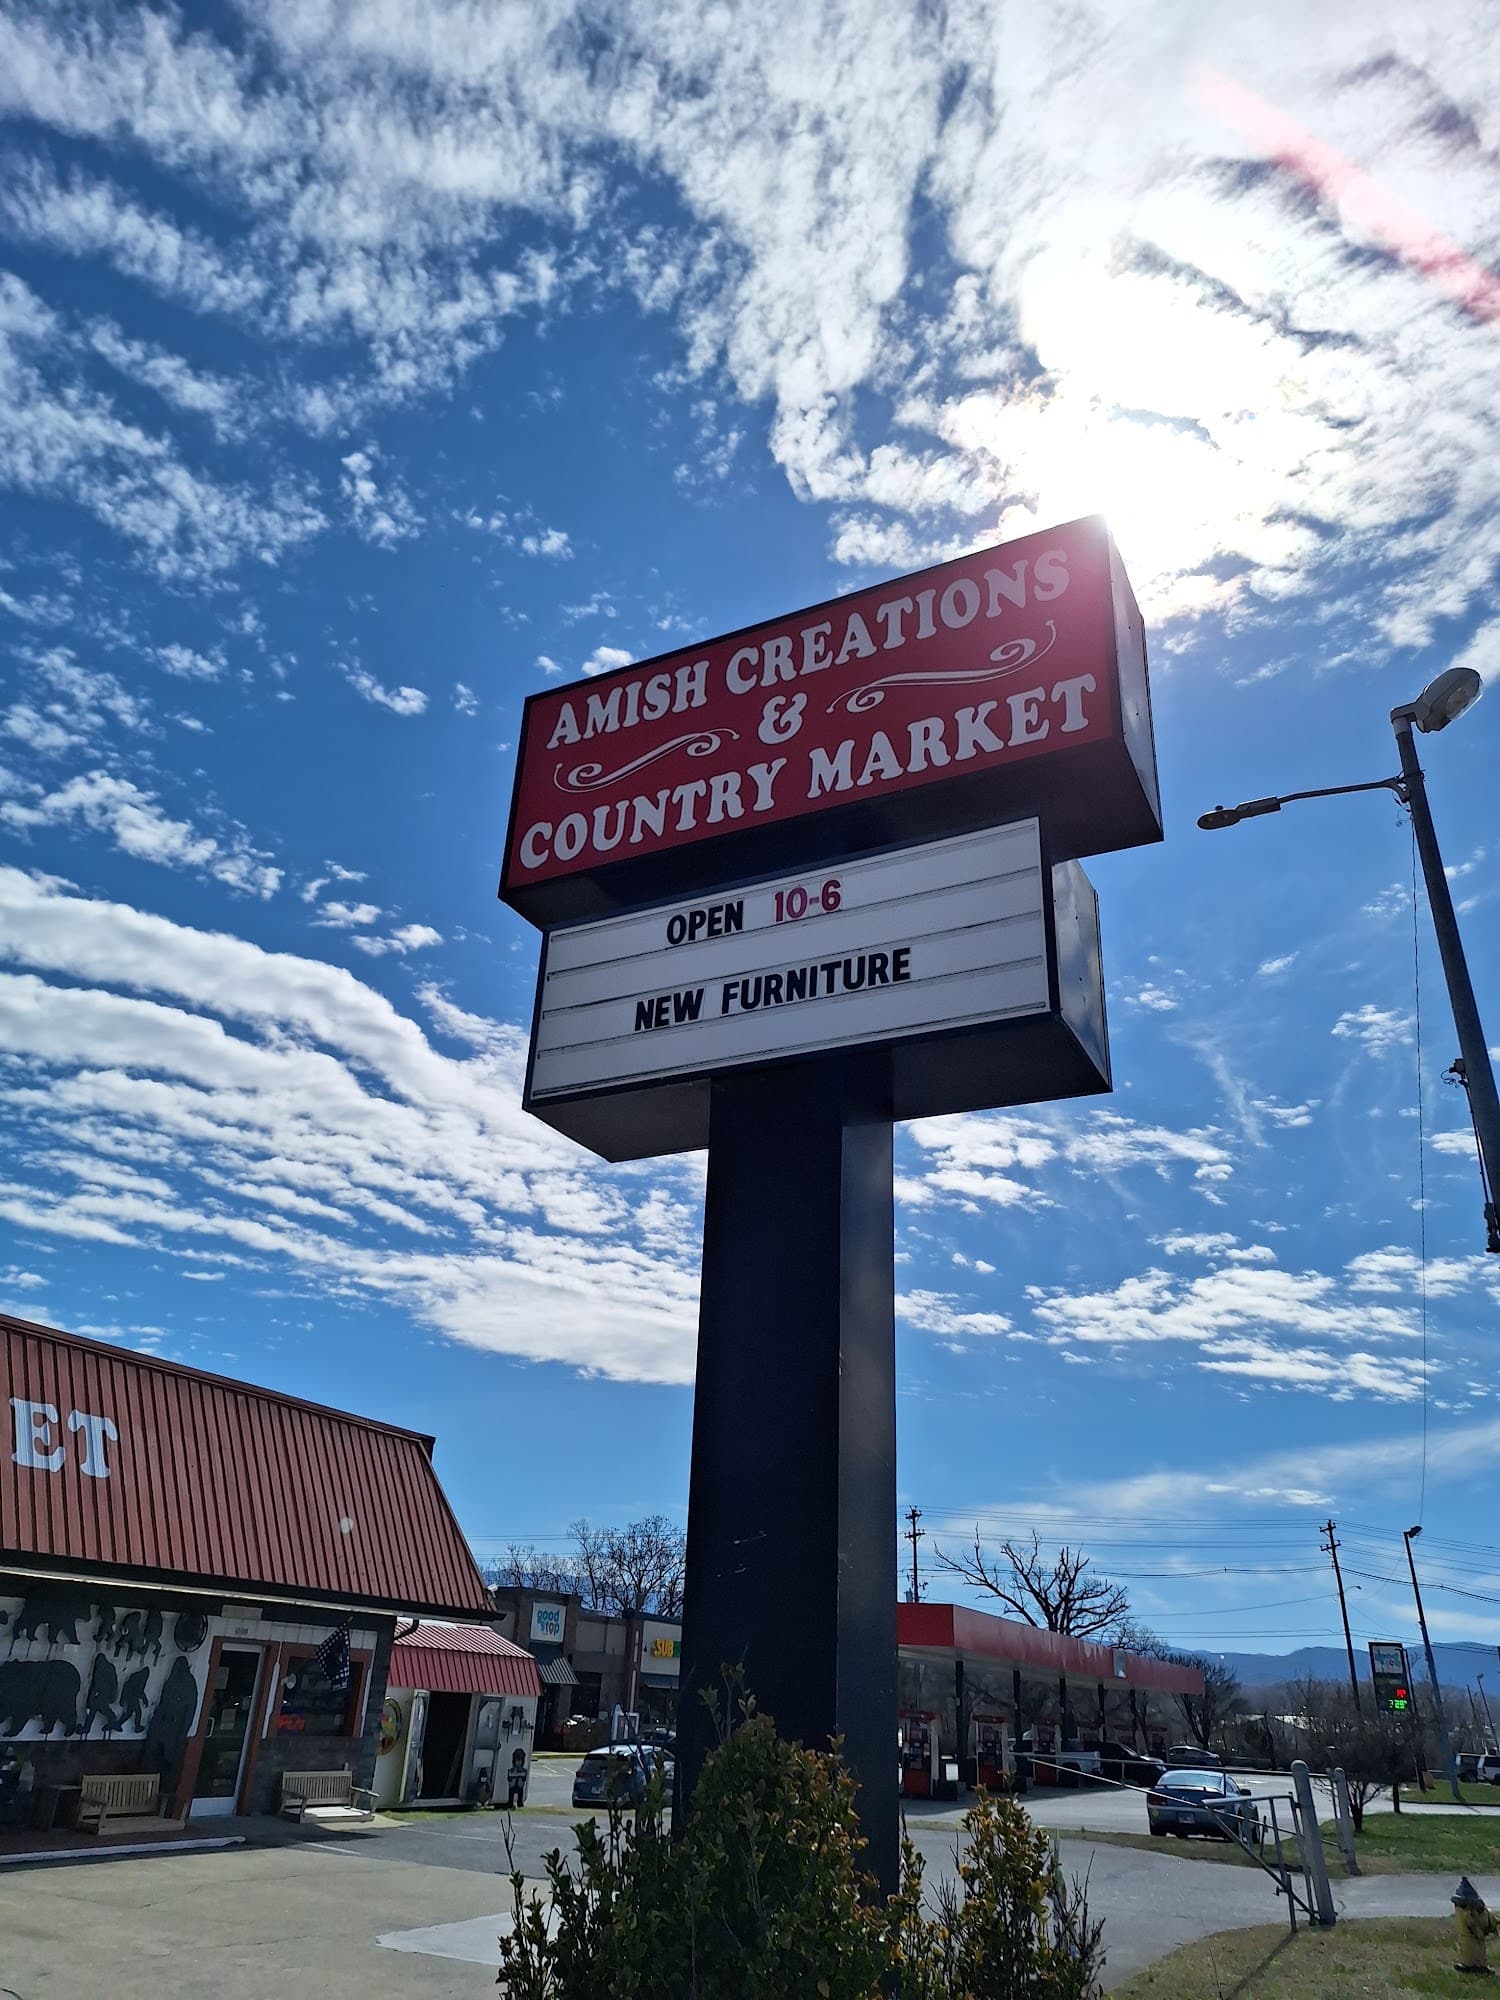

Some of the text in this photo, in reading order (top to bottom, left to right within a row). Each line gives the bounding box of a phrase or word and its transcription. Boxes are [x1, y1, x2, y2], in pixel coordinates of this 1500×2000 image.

[546, 549, 1070, 749] AMISH CREATIONS
[757, 692, 808, 745] &
[519, 673, 1097, 869] COUNTRY MARKET
[666, 879, 842, 945] OPEN 10-6
[634, 947, 911, 1032] NEW FURNITURE
[9, 1397, 118, 1478] ET
[537, 1609, 560, 1624] good
